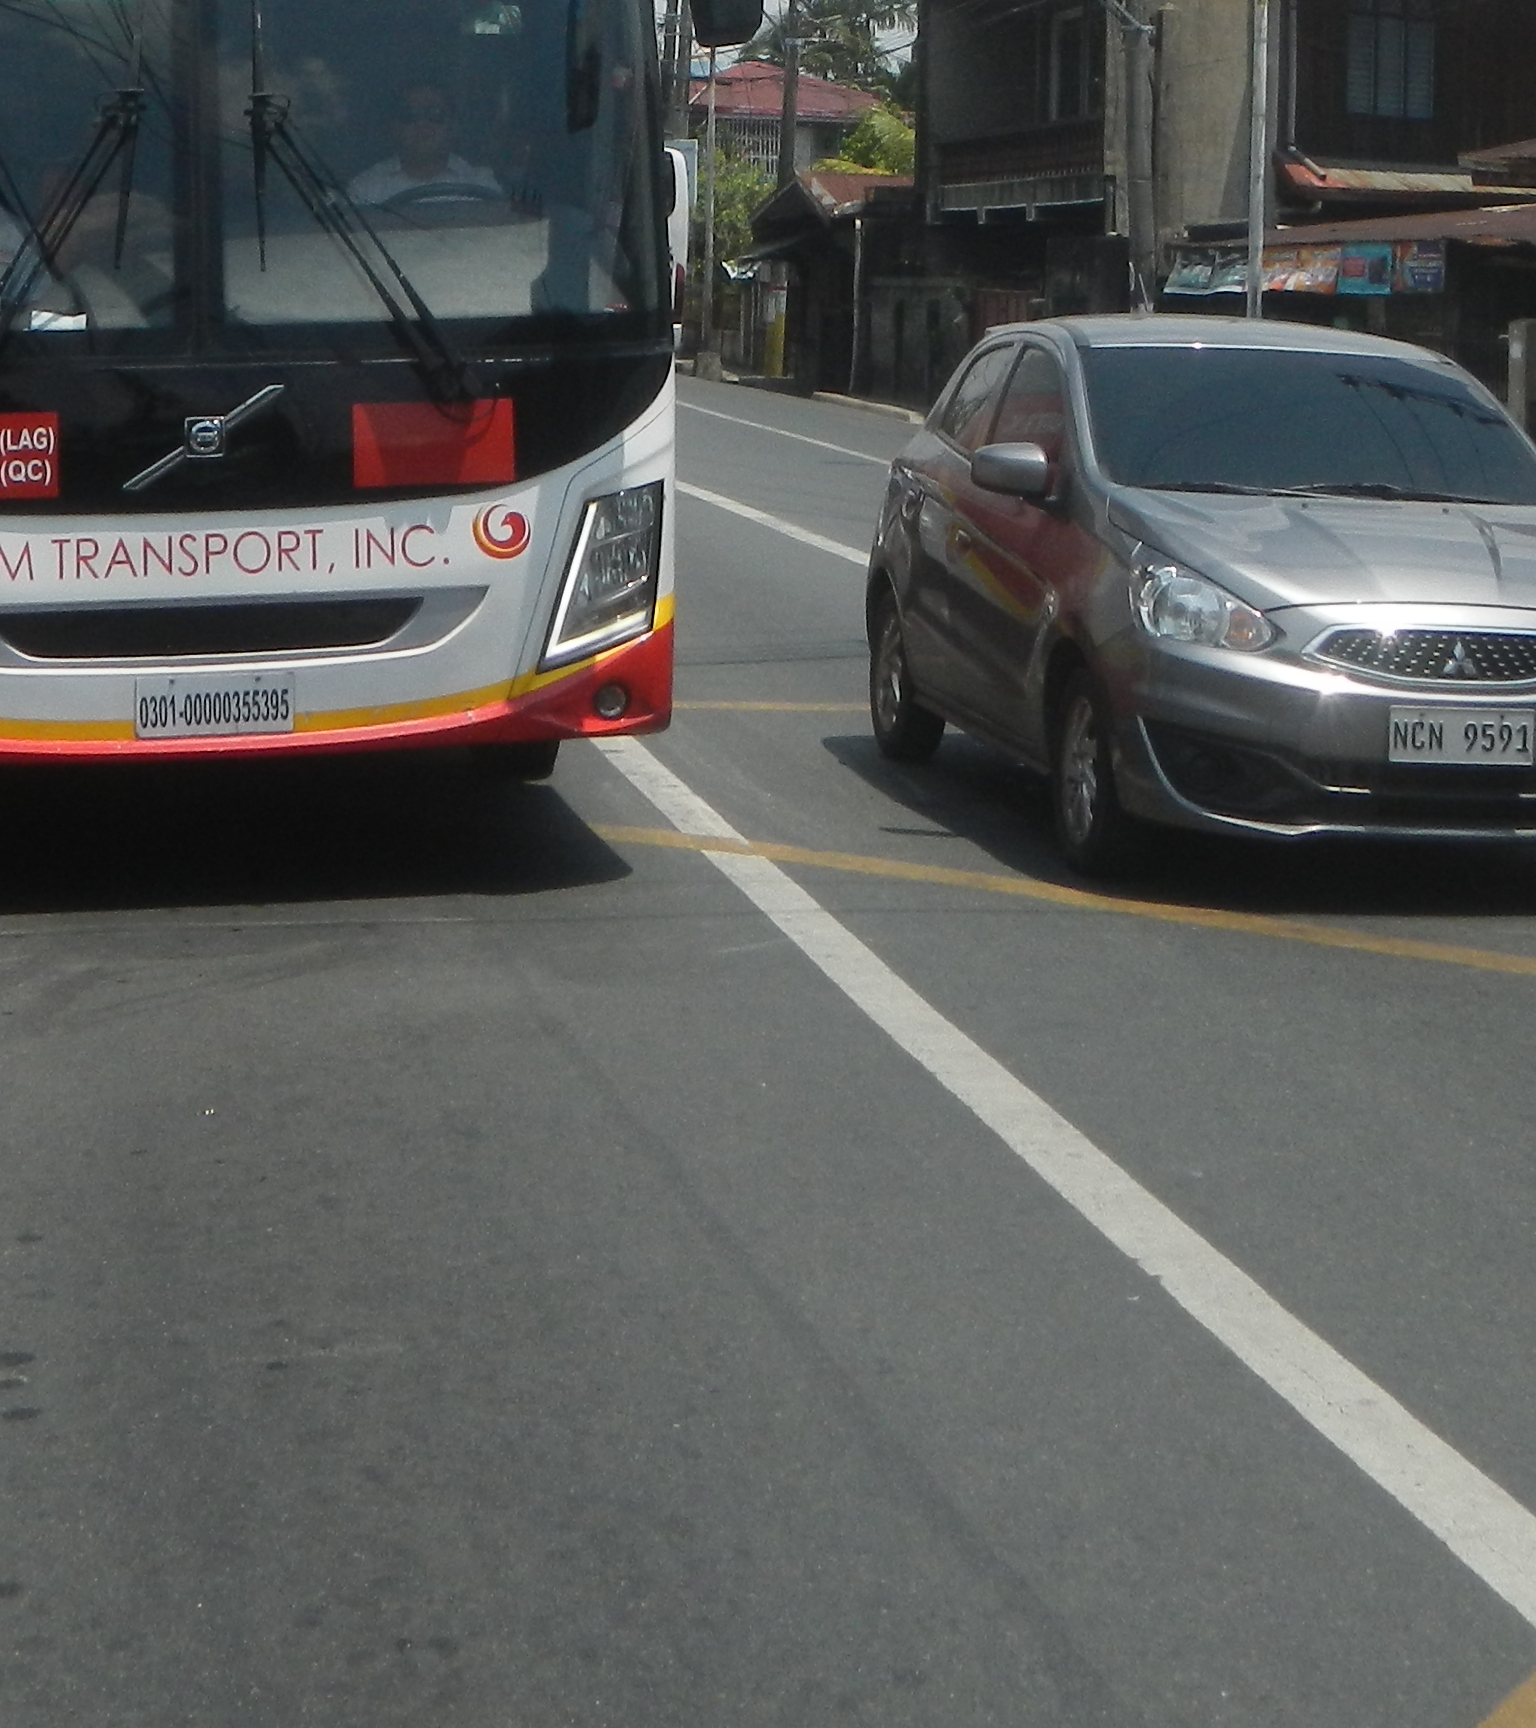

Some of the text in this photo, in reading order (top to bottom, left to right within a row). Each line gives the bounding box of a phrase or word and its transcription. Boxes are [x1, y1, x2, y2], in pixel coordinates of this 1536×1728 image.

[0, 425, 56, 456] (LAG)
[0, 458, 52, 488] (QC)
[50, 528, 335, 580] TRANSPORT,
[354, 523, 451, 570] INC.
[139, 687, 290, 729] 0301-00000355395
[1393, 719, 1530, 753] NCN 9591
